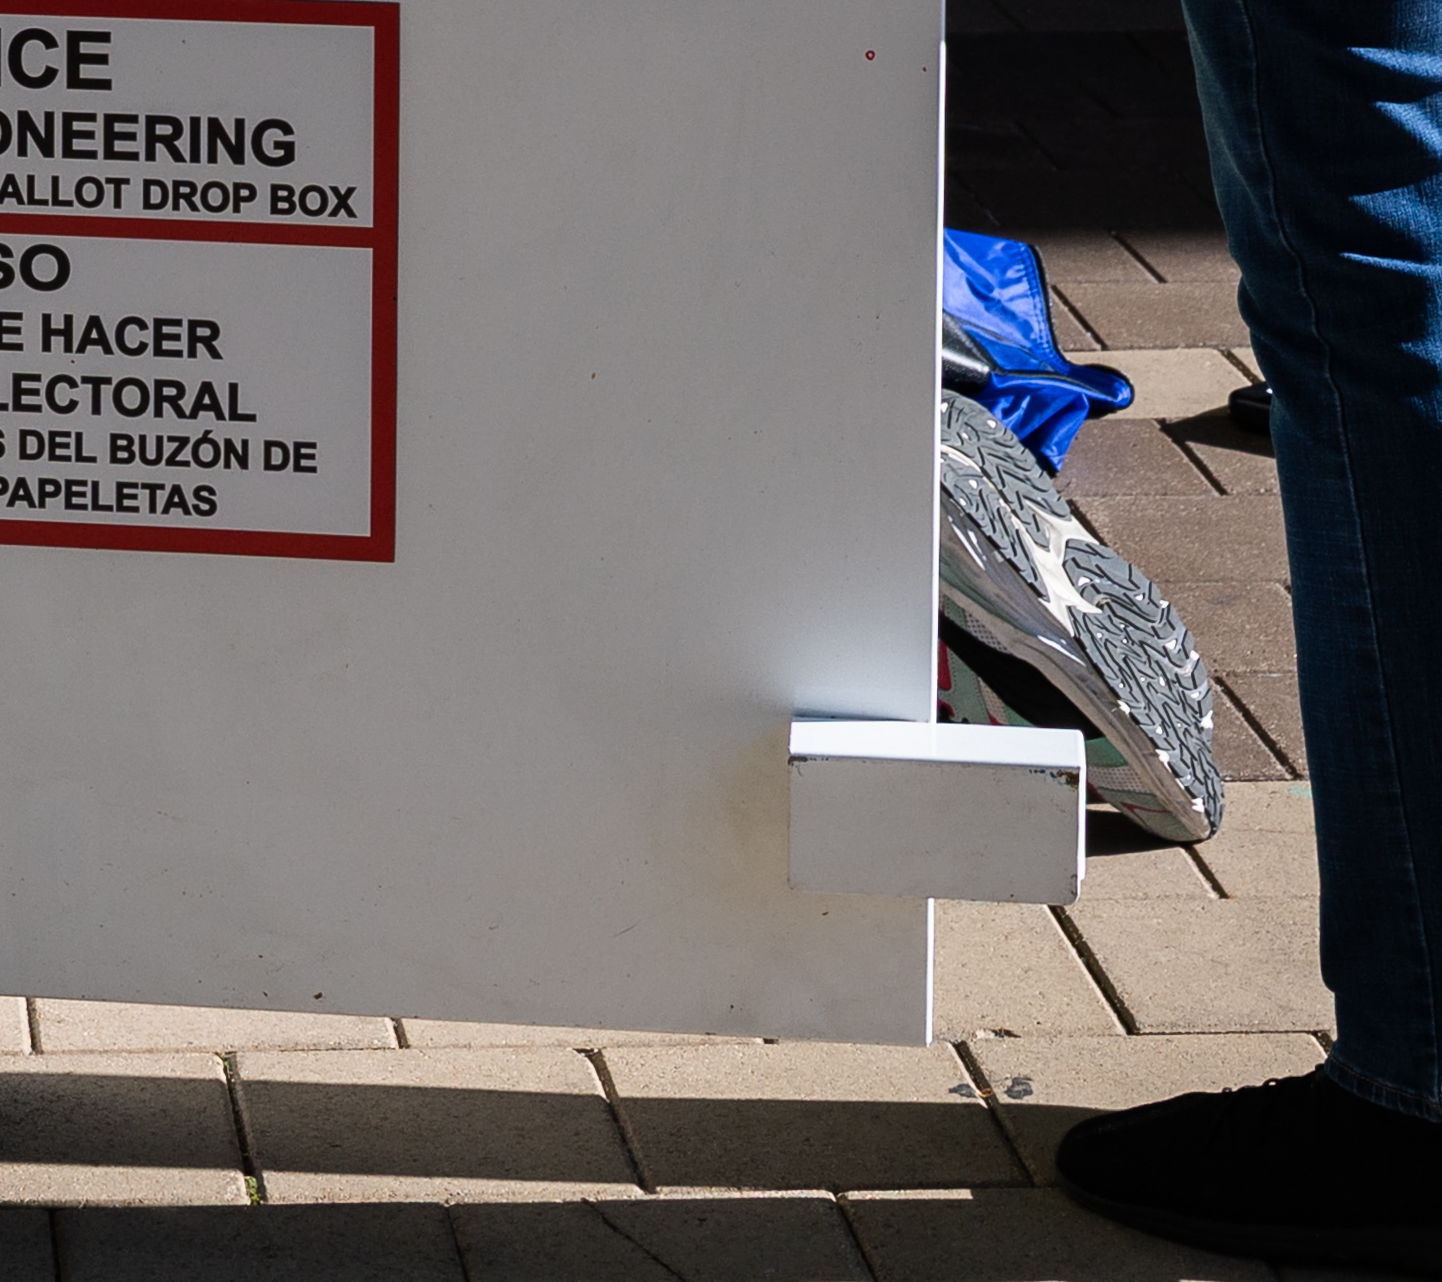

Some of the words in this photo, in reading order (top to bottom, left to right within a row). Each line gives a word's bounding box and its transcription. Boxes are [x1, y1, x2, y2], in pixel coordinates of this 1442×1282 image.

[143, 179, 257, 213] DROP
[270, 184, 357, 218] BOX
[42, 313, 223, 359] HACER
[19, 429, 97, 463] DEL
[110, 430, 248, 470] BUZÓN
[264, 440, 317, 473] DE
